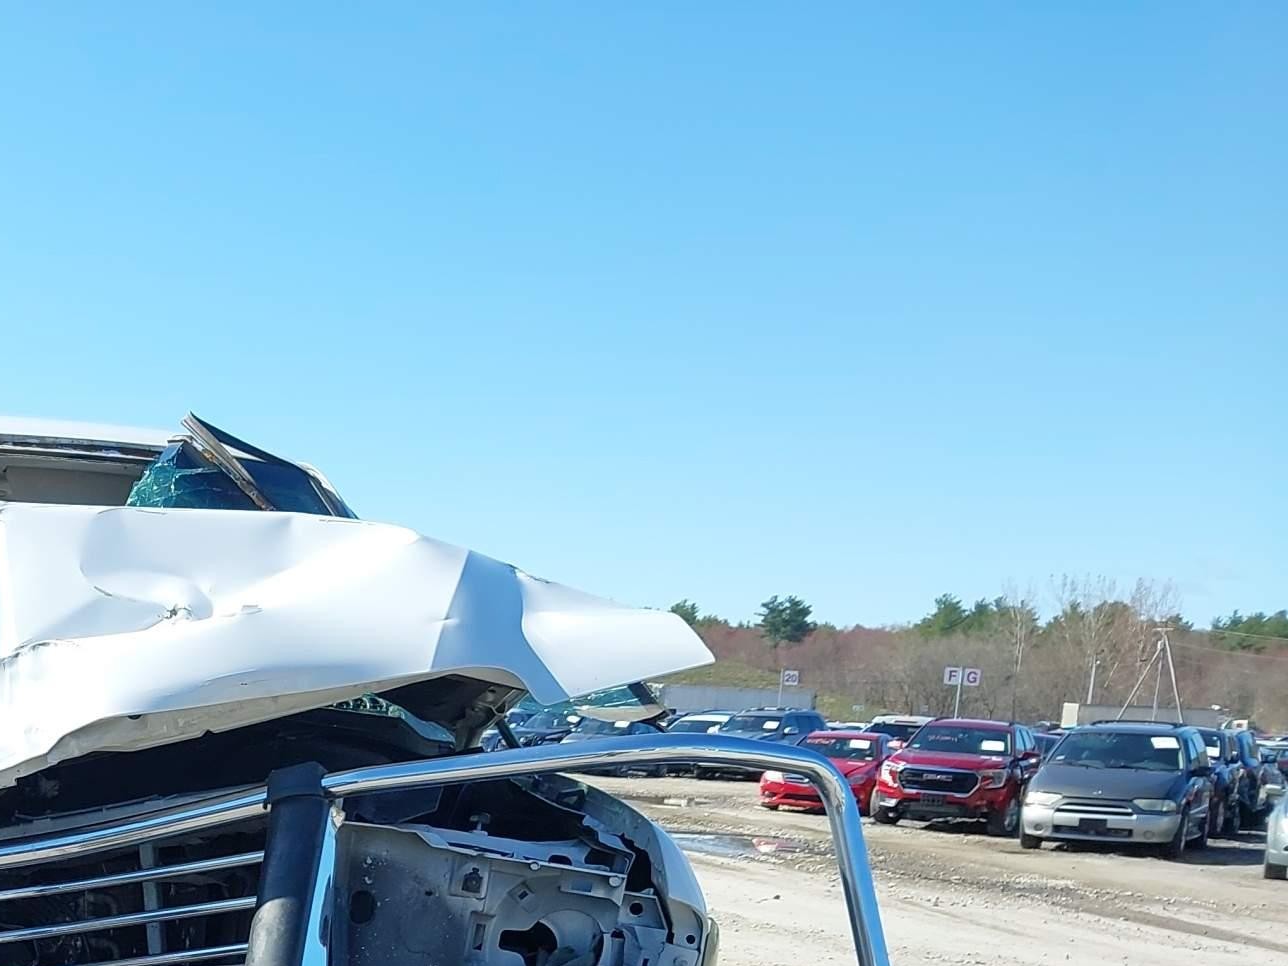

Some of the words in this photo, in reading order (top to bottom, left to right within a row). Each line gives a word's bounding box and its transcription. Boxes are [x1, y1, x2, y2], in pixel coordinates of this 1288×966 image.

[785, 673, 798, 682] 20
[948, 669, 958, 682] F
[966, 671, 978, 684] G
